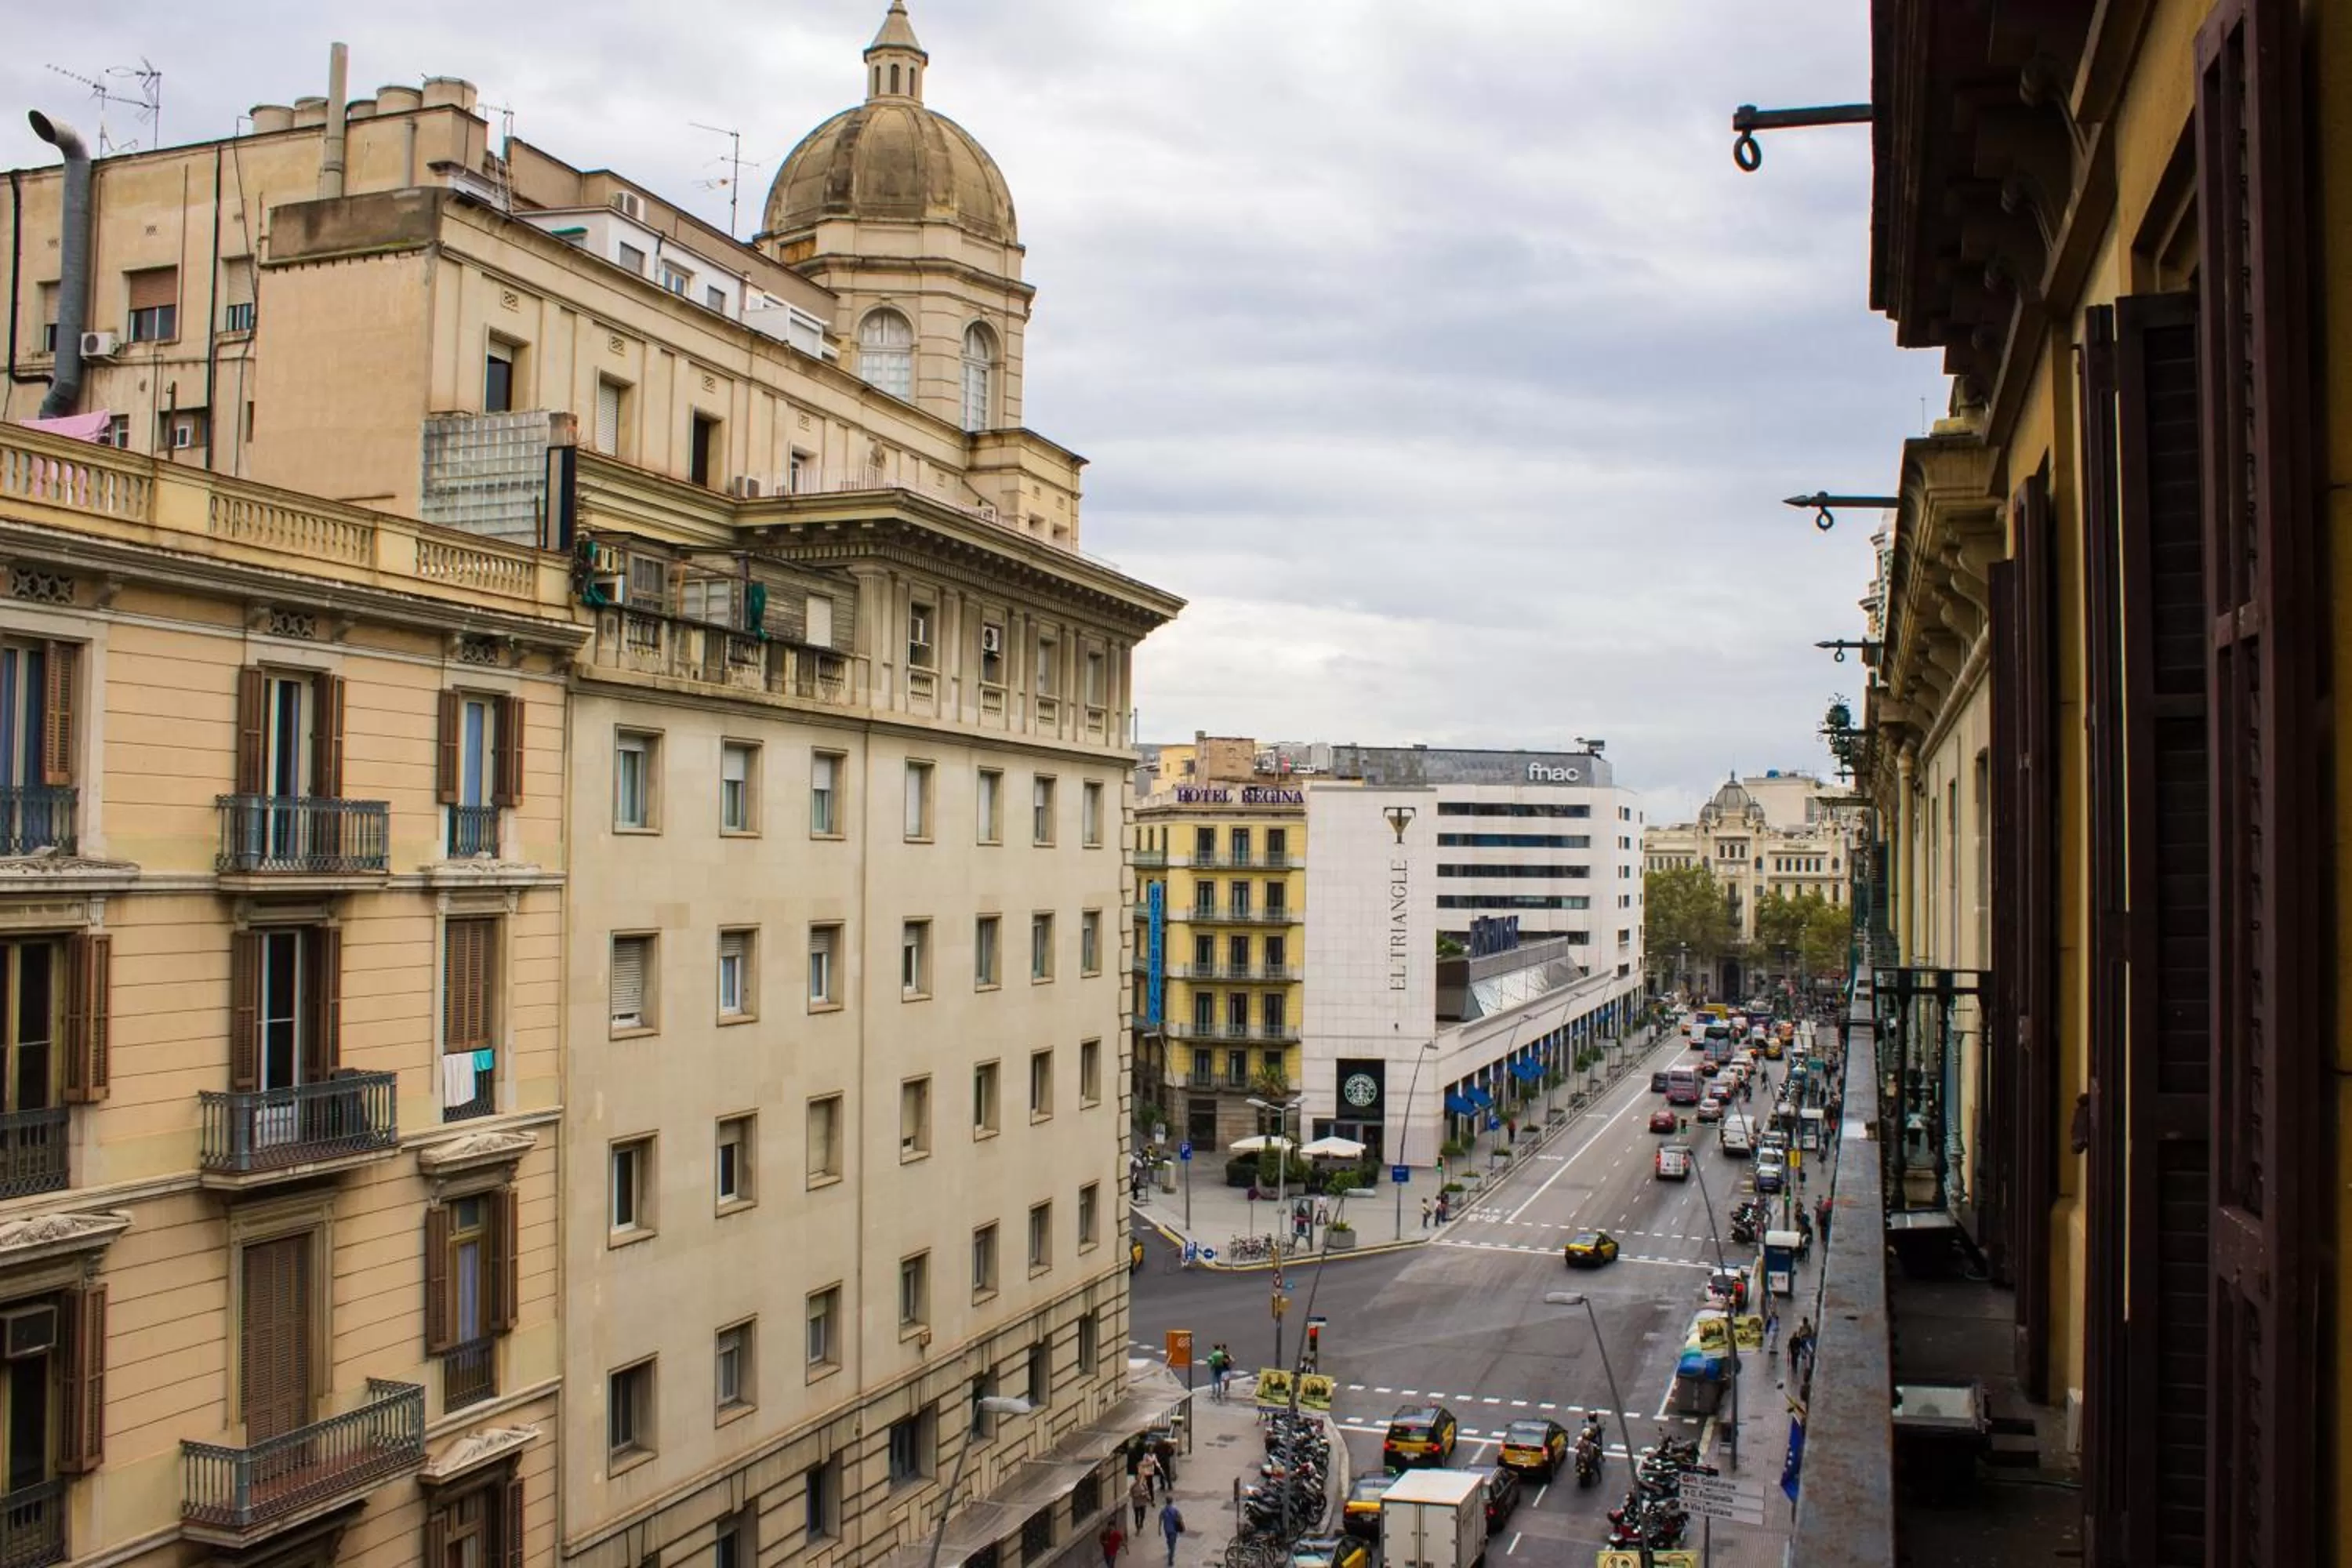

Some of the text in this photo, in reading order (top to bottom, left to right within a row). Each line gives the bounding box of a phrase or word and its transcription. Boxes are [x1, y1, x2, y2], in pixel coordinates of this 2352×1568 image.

[1528, 762, 1579, 782] fnac
[1177, 787, 1305, 804] HOTEL REGINA
[1150, 887, 1160, 946] HOTEL
[1389, 860, 1408, 990] EL TRIANGLE
